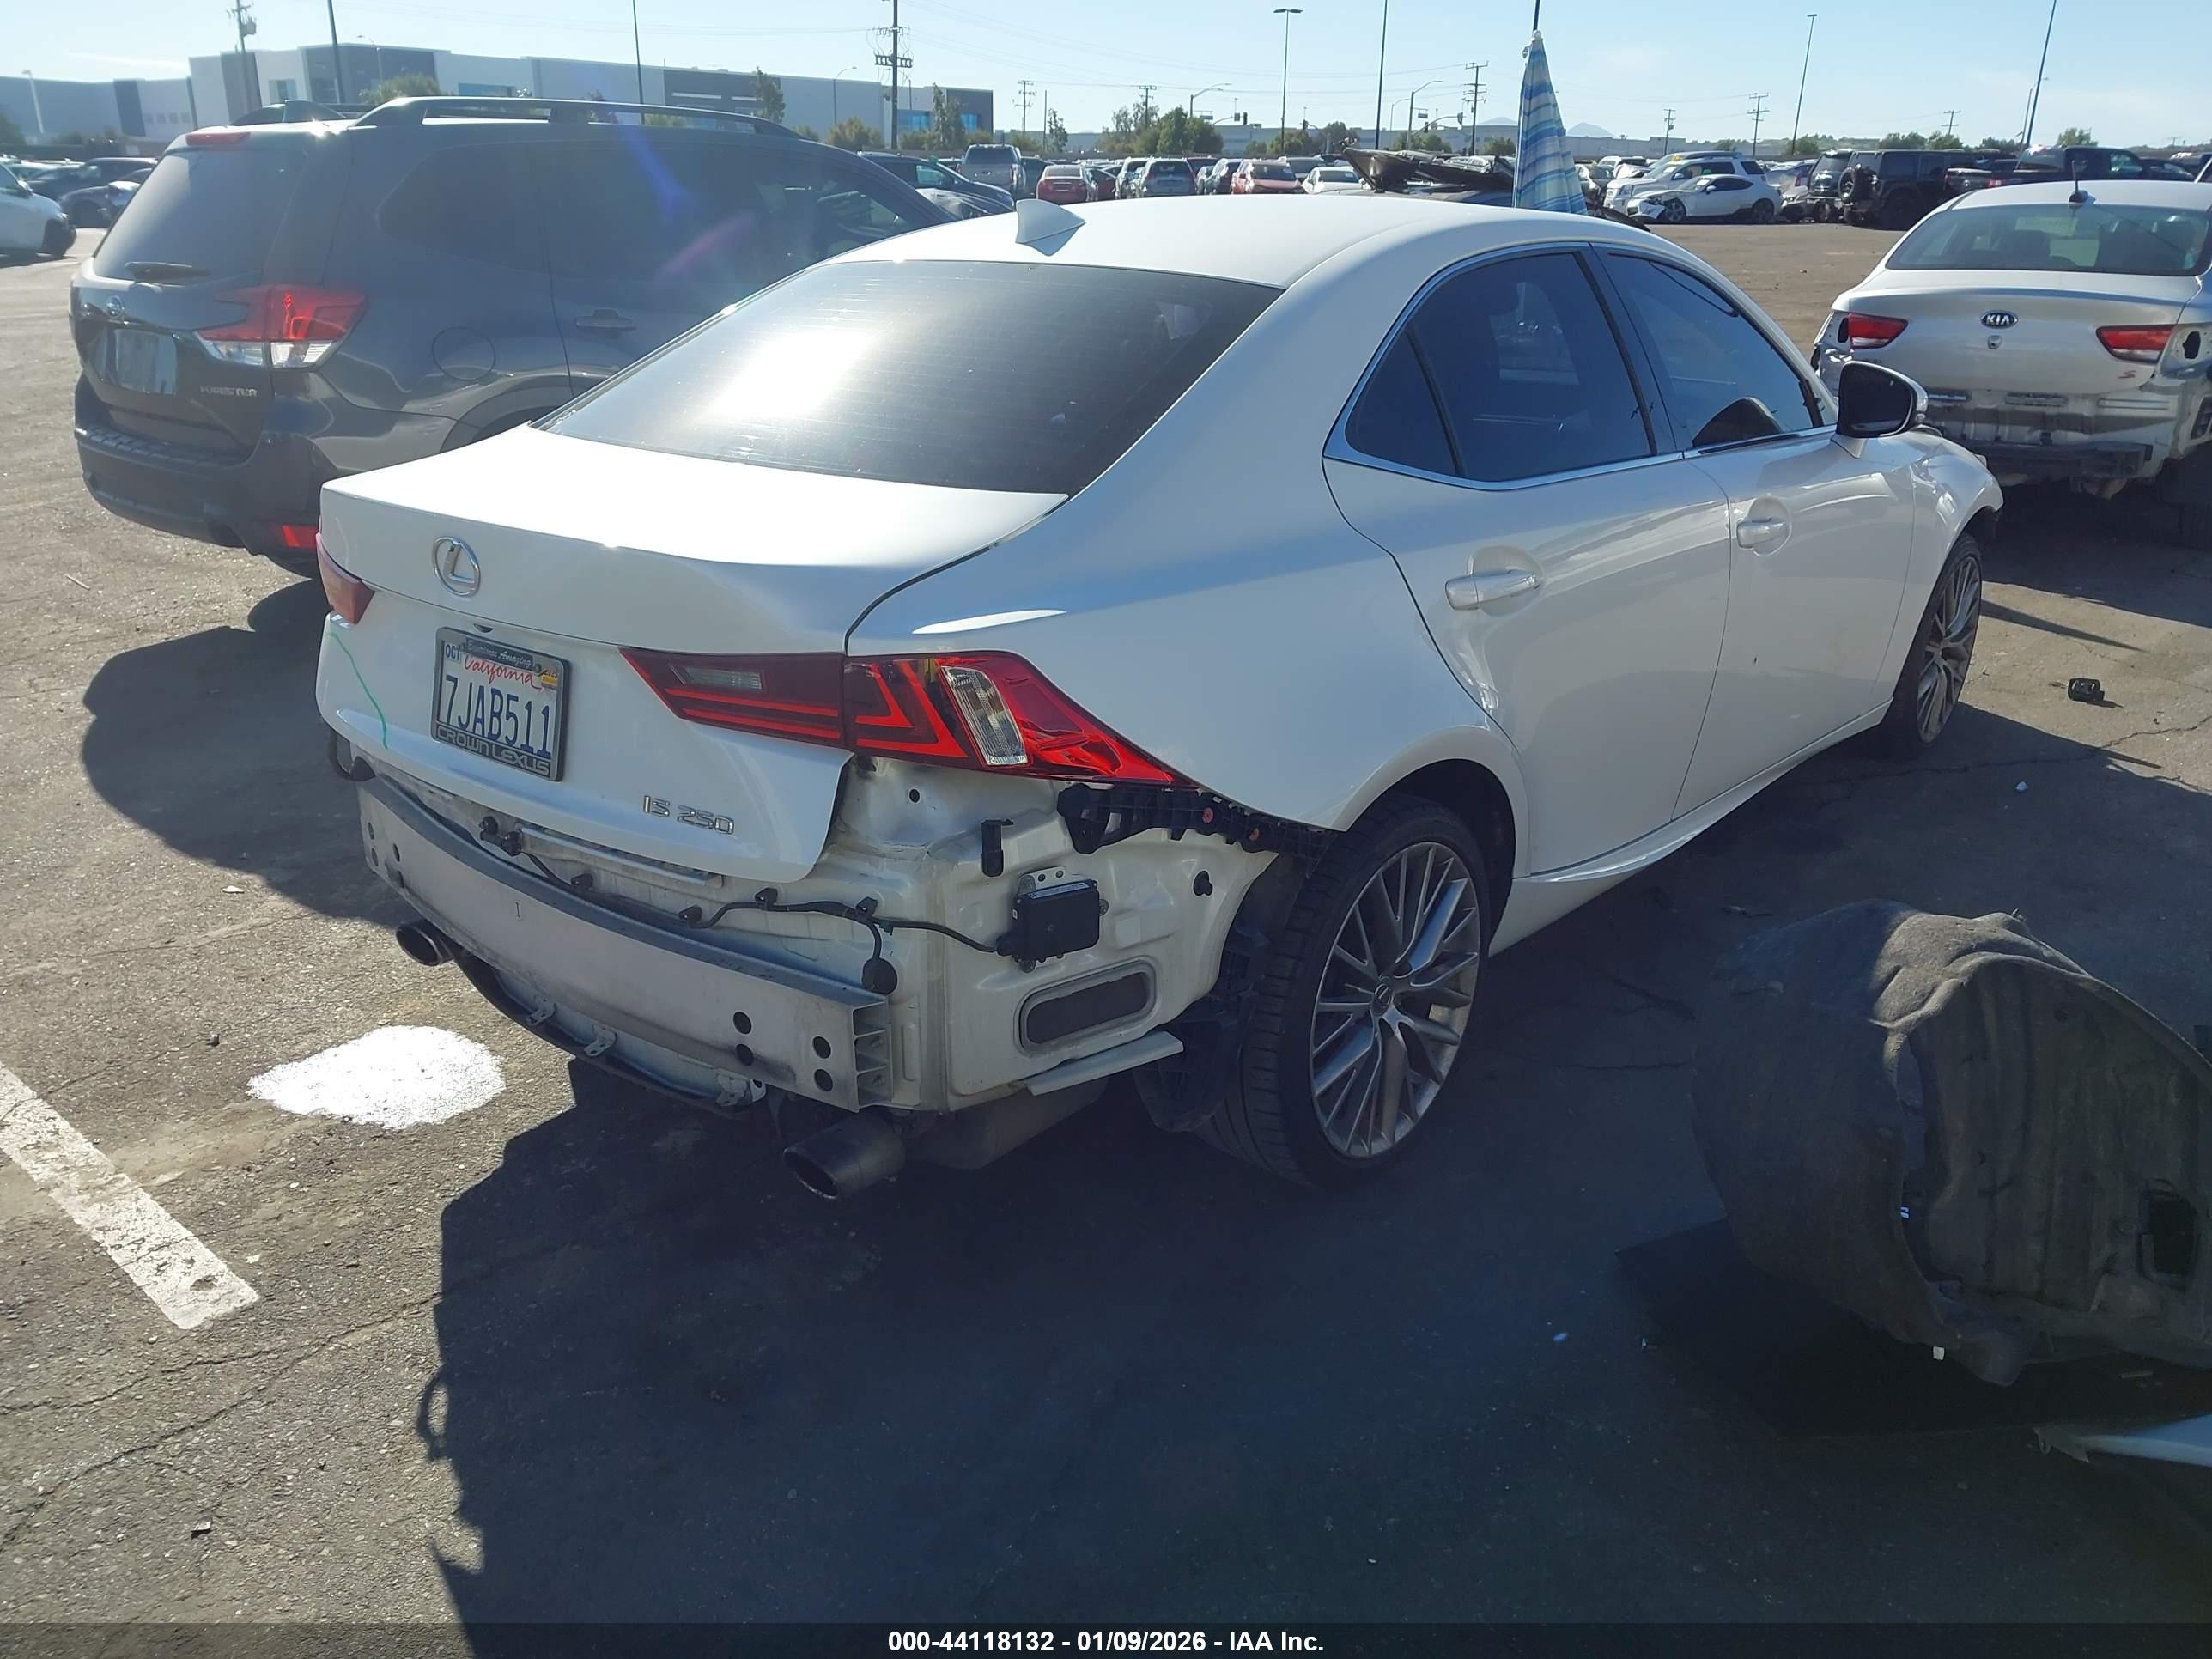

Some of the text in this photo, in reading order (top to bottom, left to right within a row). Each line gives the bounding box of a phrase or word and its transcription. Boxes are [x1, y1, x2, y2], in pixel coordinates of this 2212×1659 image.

[1985, 314, 2010, 325] KIA
[464, 655, 542, 690] California
[445, 674, 551, 759] 7JAB511
[437, 726, 550, 776] CROWN LEXUS
[643, 795, 734, 835] IS 250
